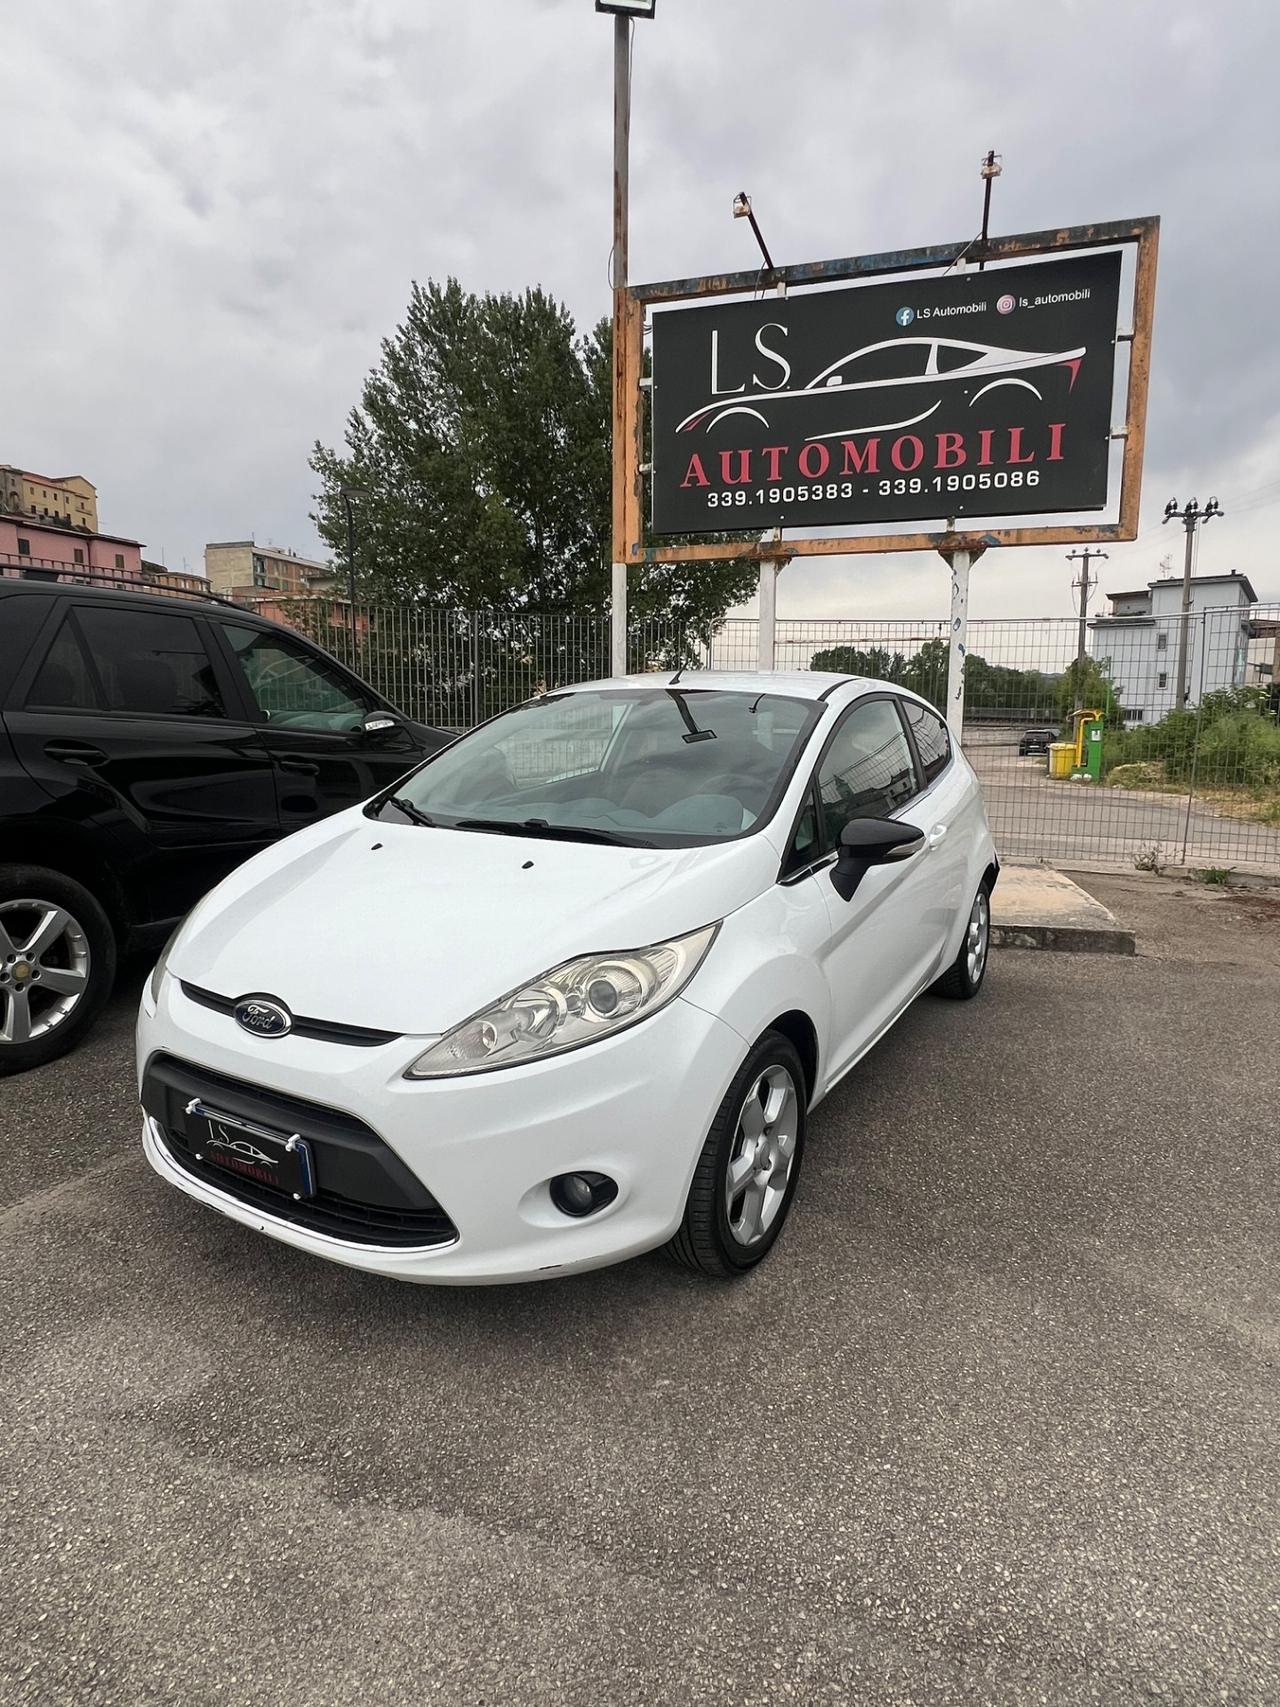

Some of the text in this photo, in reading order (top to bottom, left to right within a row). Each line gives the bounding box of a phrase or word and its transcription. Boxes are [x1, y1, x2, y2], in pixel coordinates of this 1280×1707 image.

[917, 301, 987, 319] LS Automobili
[1018, 288, 1091, 309] ls_automobili
[679, 423, 1067, 488] AUTOMOBILI
[707, 483, 853, 508] 339.1905383
[878, 470, 1040, 497] 339.1905086
[242, 1004, 276, 1029] Ford
